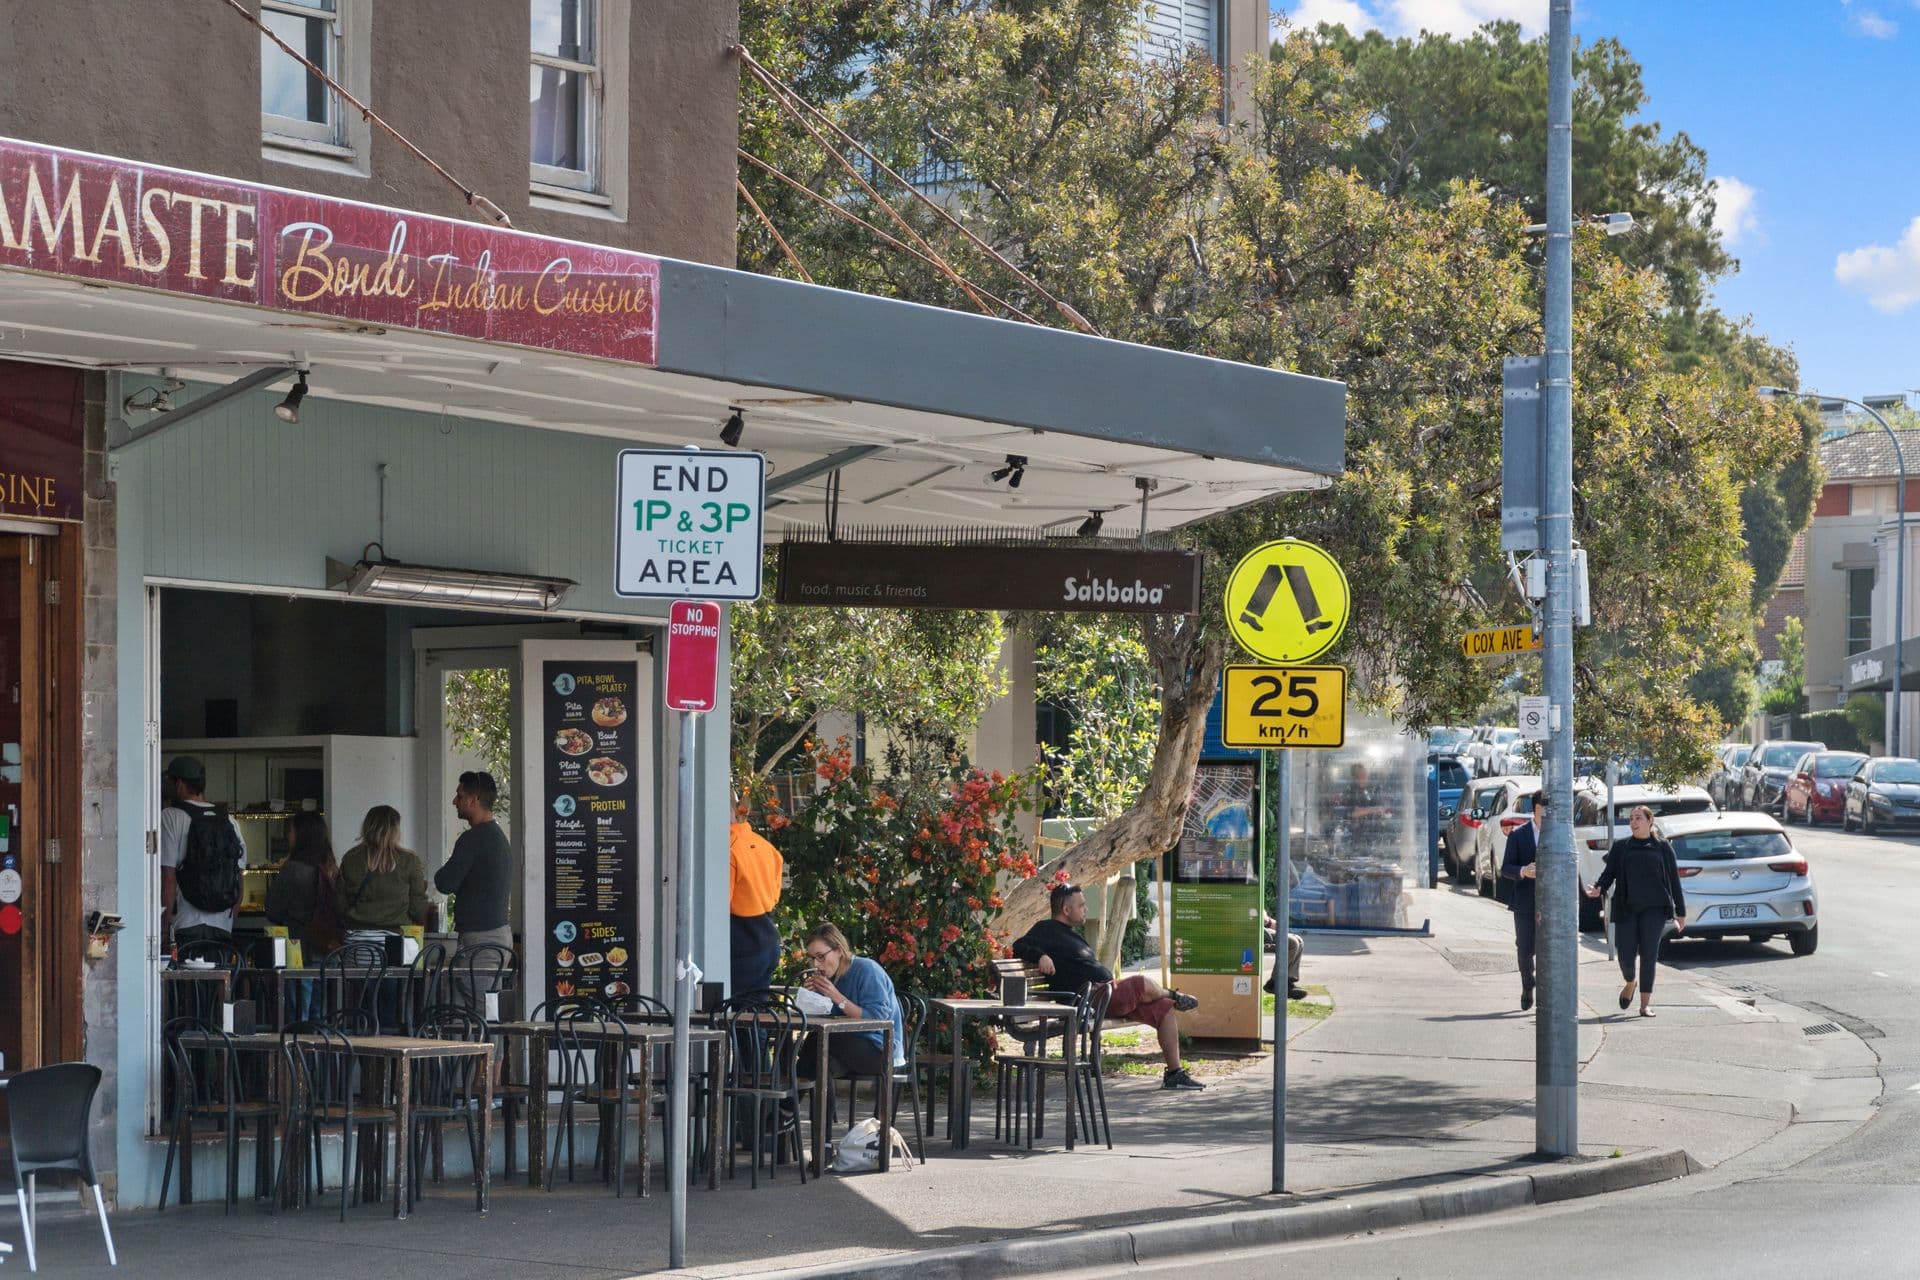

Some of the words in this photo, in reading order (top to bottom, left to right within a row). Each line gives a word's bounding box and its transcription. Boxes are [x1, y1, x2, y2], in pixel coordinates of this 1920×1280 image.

[281, 220, 415, 302] Bondi
[418, 250, 529, 311] Indian
[533, 257, 648, 316] Cuisine
[653, 465, 728, 492] END
[633, 499, 671, 531] 1P
[677, 510, 692, 532] &
[699, 501, 750, 533] 3P
[657, 539, 724, 554] TICKET
[638, 558, 737, 586] AREA
[800, 583, 831, 596] food,
[836, 584, 870, 596] music
[873, 584, 882, 596] &
[886, 584, 928, 598] friends
[1063, 576, 1163, 604] Sabbaba
[686, 607, 704, 622] NO
[671, 623, 717, 637] STOPPING
[1473, 631, 1495, 654] COX
[1501, 628, 1523, 651] AVE
[595, 674, 616, 684] BOWL
[601, 683, 627, 693] PLATE?
[1250, 675, 1319, 718] 25
[565, 701, 583, 711] Pita
[1259, 724, 1308, 739] km/h
[559, 761, 581, 770] Plate
[591, 800, 626, 811] PROTEIN
[597, 817, 612, 825] Beef
[597, 846, 616, 854] Lamb
[555, 857, 577, 865] Chicken
